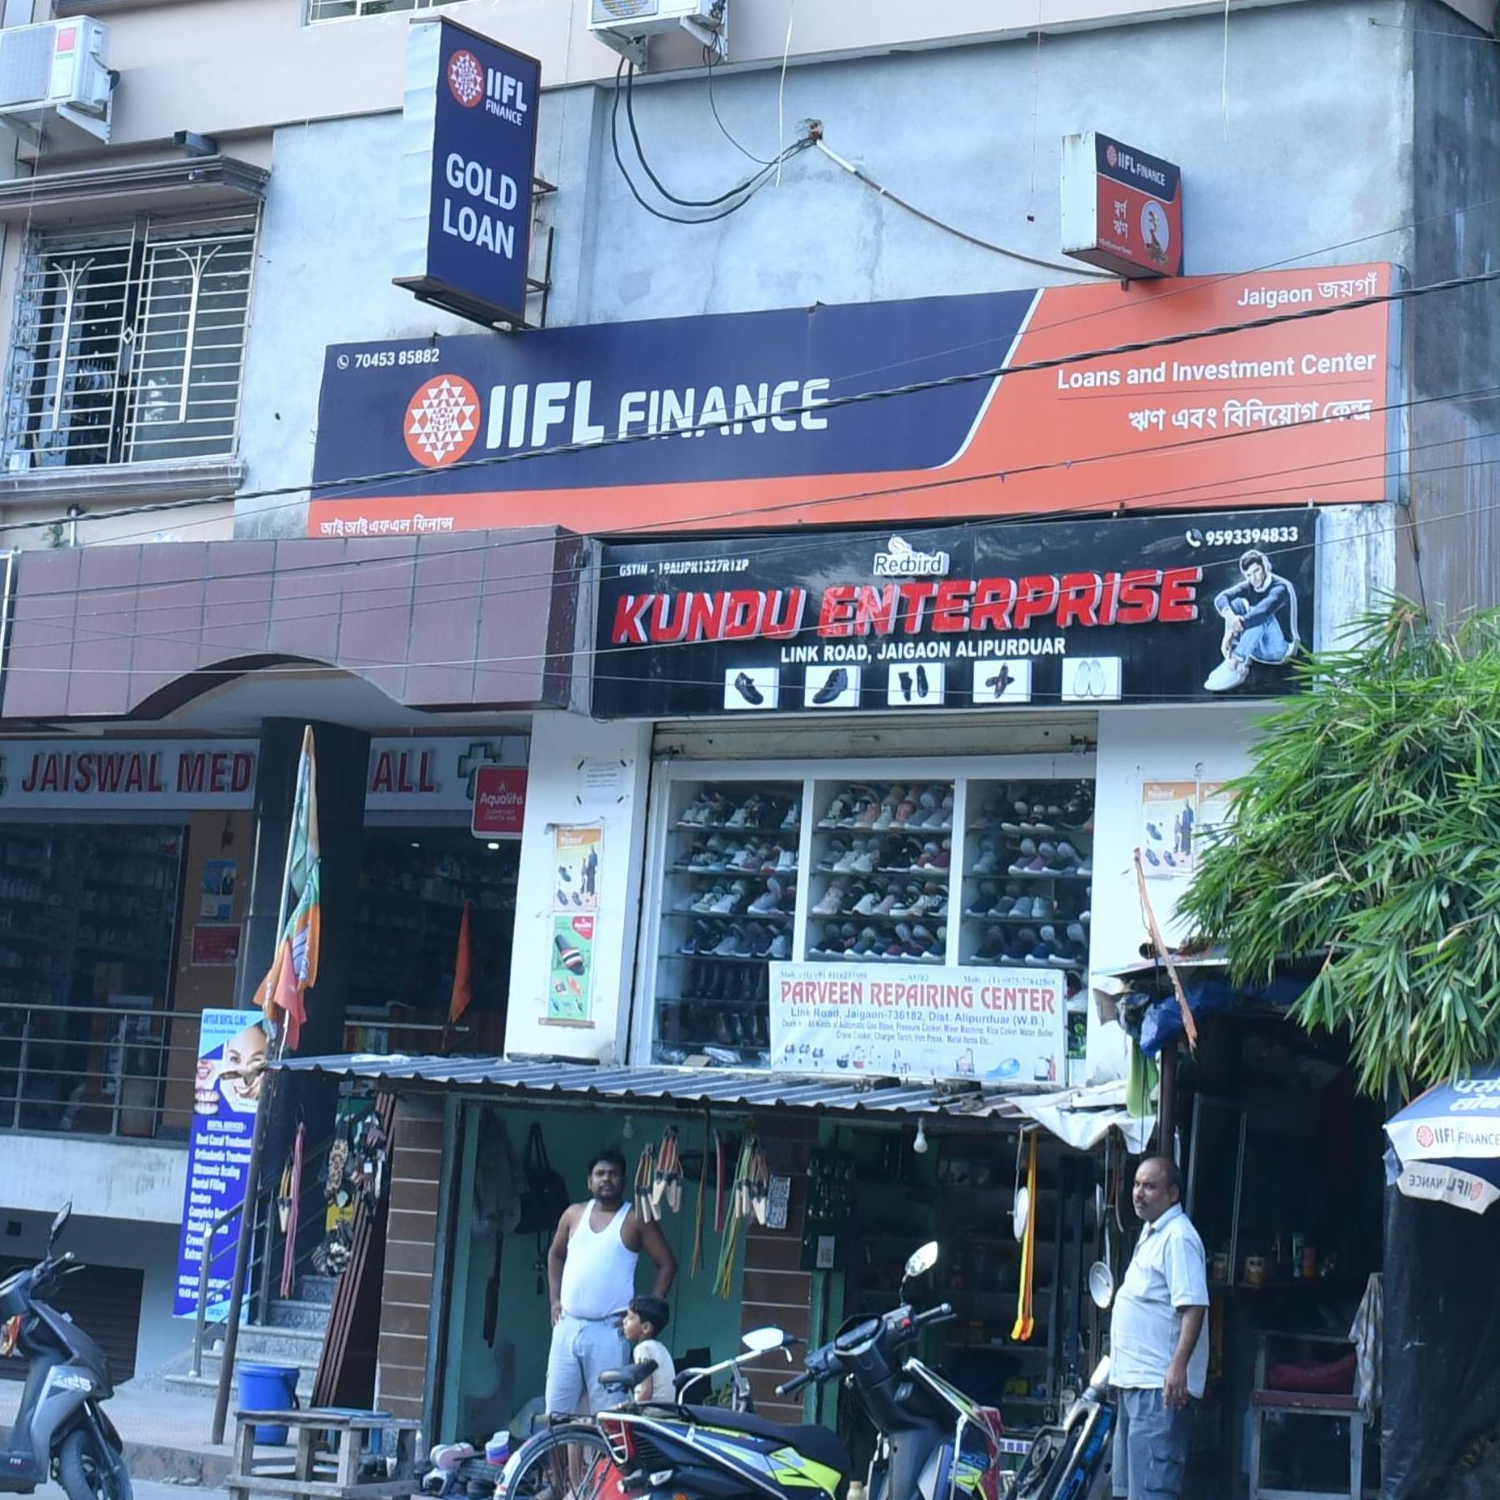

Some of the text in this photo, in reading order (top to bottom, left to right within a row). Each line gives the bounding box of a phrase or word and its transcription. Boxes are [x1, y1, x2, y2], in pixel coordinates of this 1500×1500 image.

[486, 67, 528, 113] IIFL
[485, 99, 524, 127] FINANCE
[445, 152, 518, 211] GOLD
[1118, 151, 1165, 186] IIFL FINANCE
[442, 198, 515, 260] LOAN
[1237, 287, 1313, 308] Jaigaon
[354, 347, 440, 369] 70453 85882
[1057, 352, 1377, 389] Loans and Investment Center
[485, 377, 831, 450] IIFL FINANCE
[1171, 407, 1217, 430] এবং
[1205, 526, 1299, 546] 9593394833
[619, 563, 648, 577] GSTIN
[874, 551, 949, 577] Redbird
[611, 565, 1204, 645] KUNDU ENTERPRISE
[780, 637, 1066, 665] LINK ROAD, JAIGAON ALIPURDUAR
[22, 752, 164, 794] JAISWAL
[371, 751, 437, 793] ALL
[780, 981, 1056, 1015] PARVEEN REPAIRING CENTER
[790, 1008, 812, 1019] Link
[813, 1008, 842, 1020] Road,
[955, 1012, 1010, 1026] Alipurduar
[1457, 1129, 1500, 1147] FINANCE
